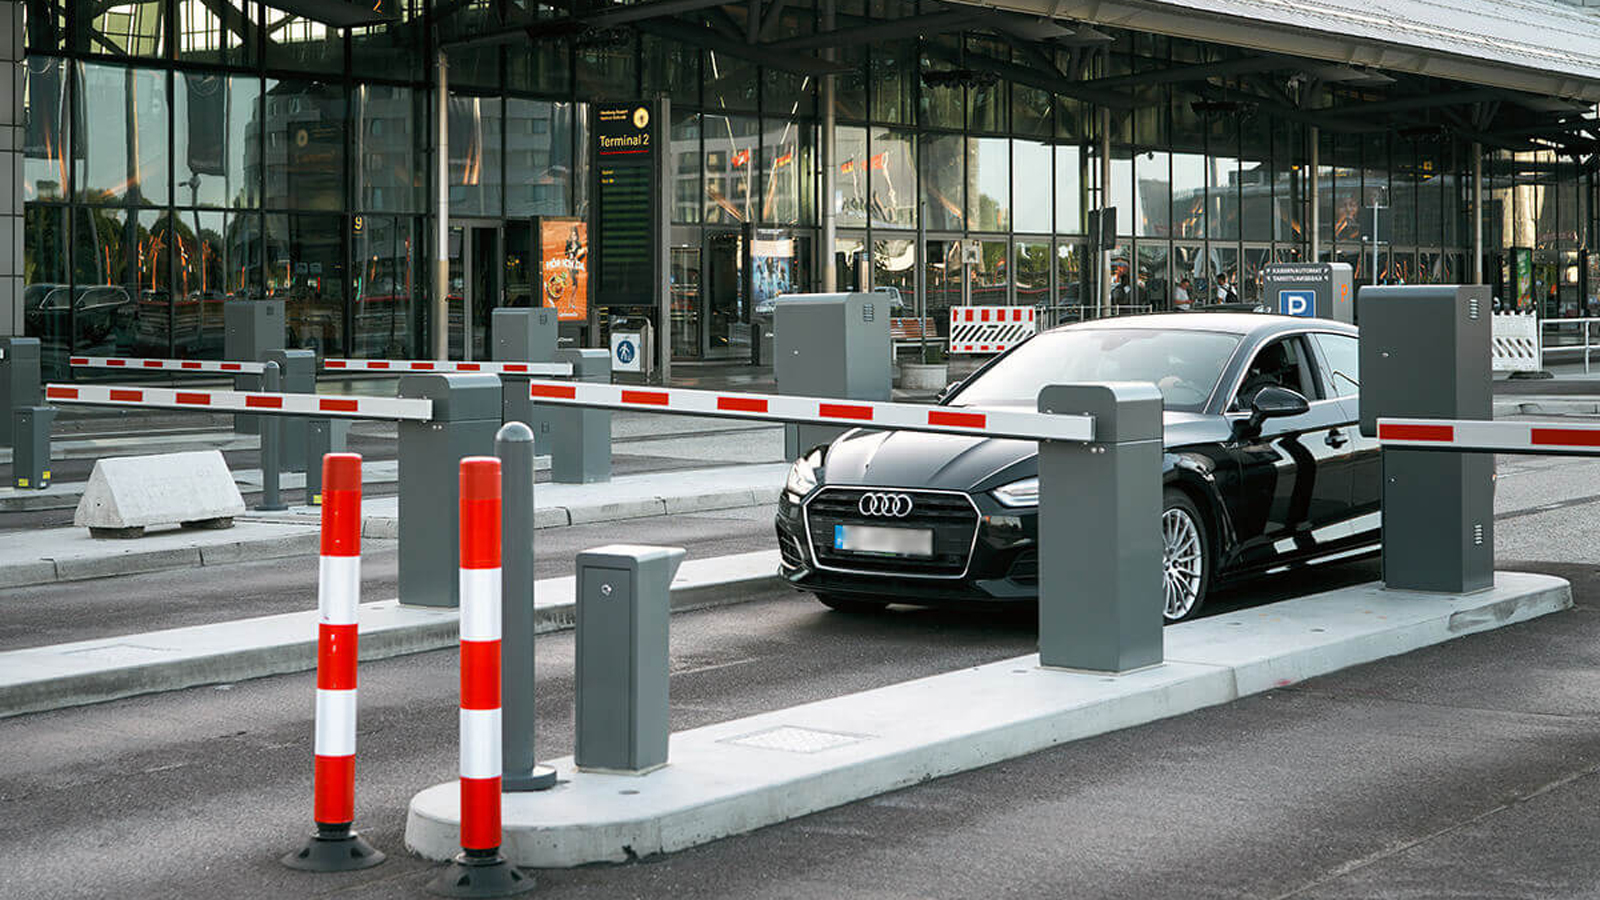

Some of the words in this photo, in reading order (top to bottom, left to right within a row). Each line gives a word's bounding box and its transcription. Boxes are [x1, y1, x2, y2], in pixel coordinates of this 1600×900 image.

[599, 134, 641, 148] Terminal
[642, 133, 650, 146] 2
[354, 216, 363, 230] 9
[1288, 296, 1307, 315] P
